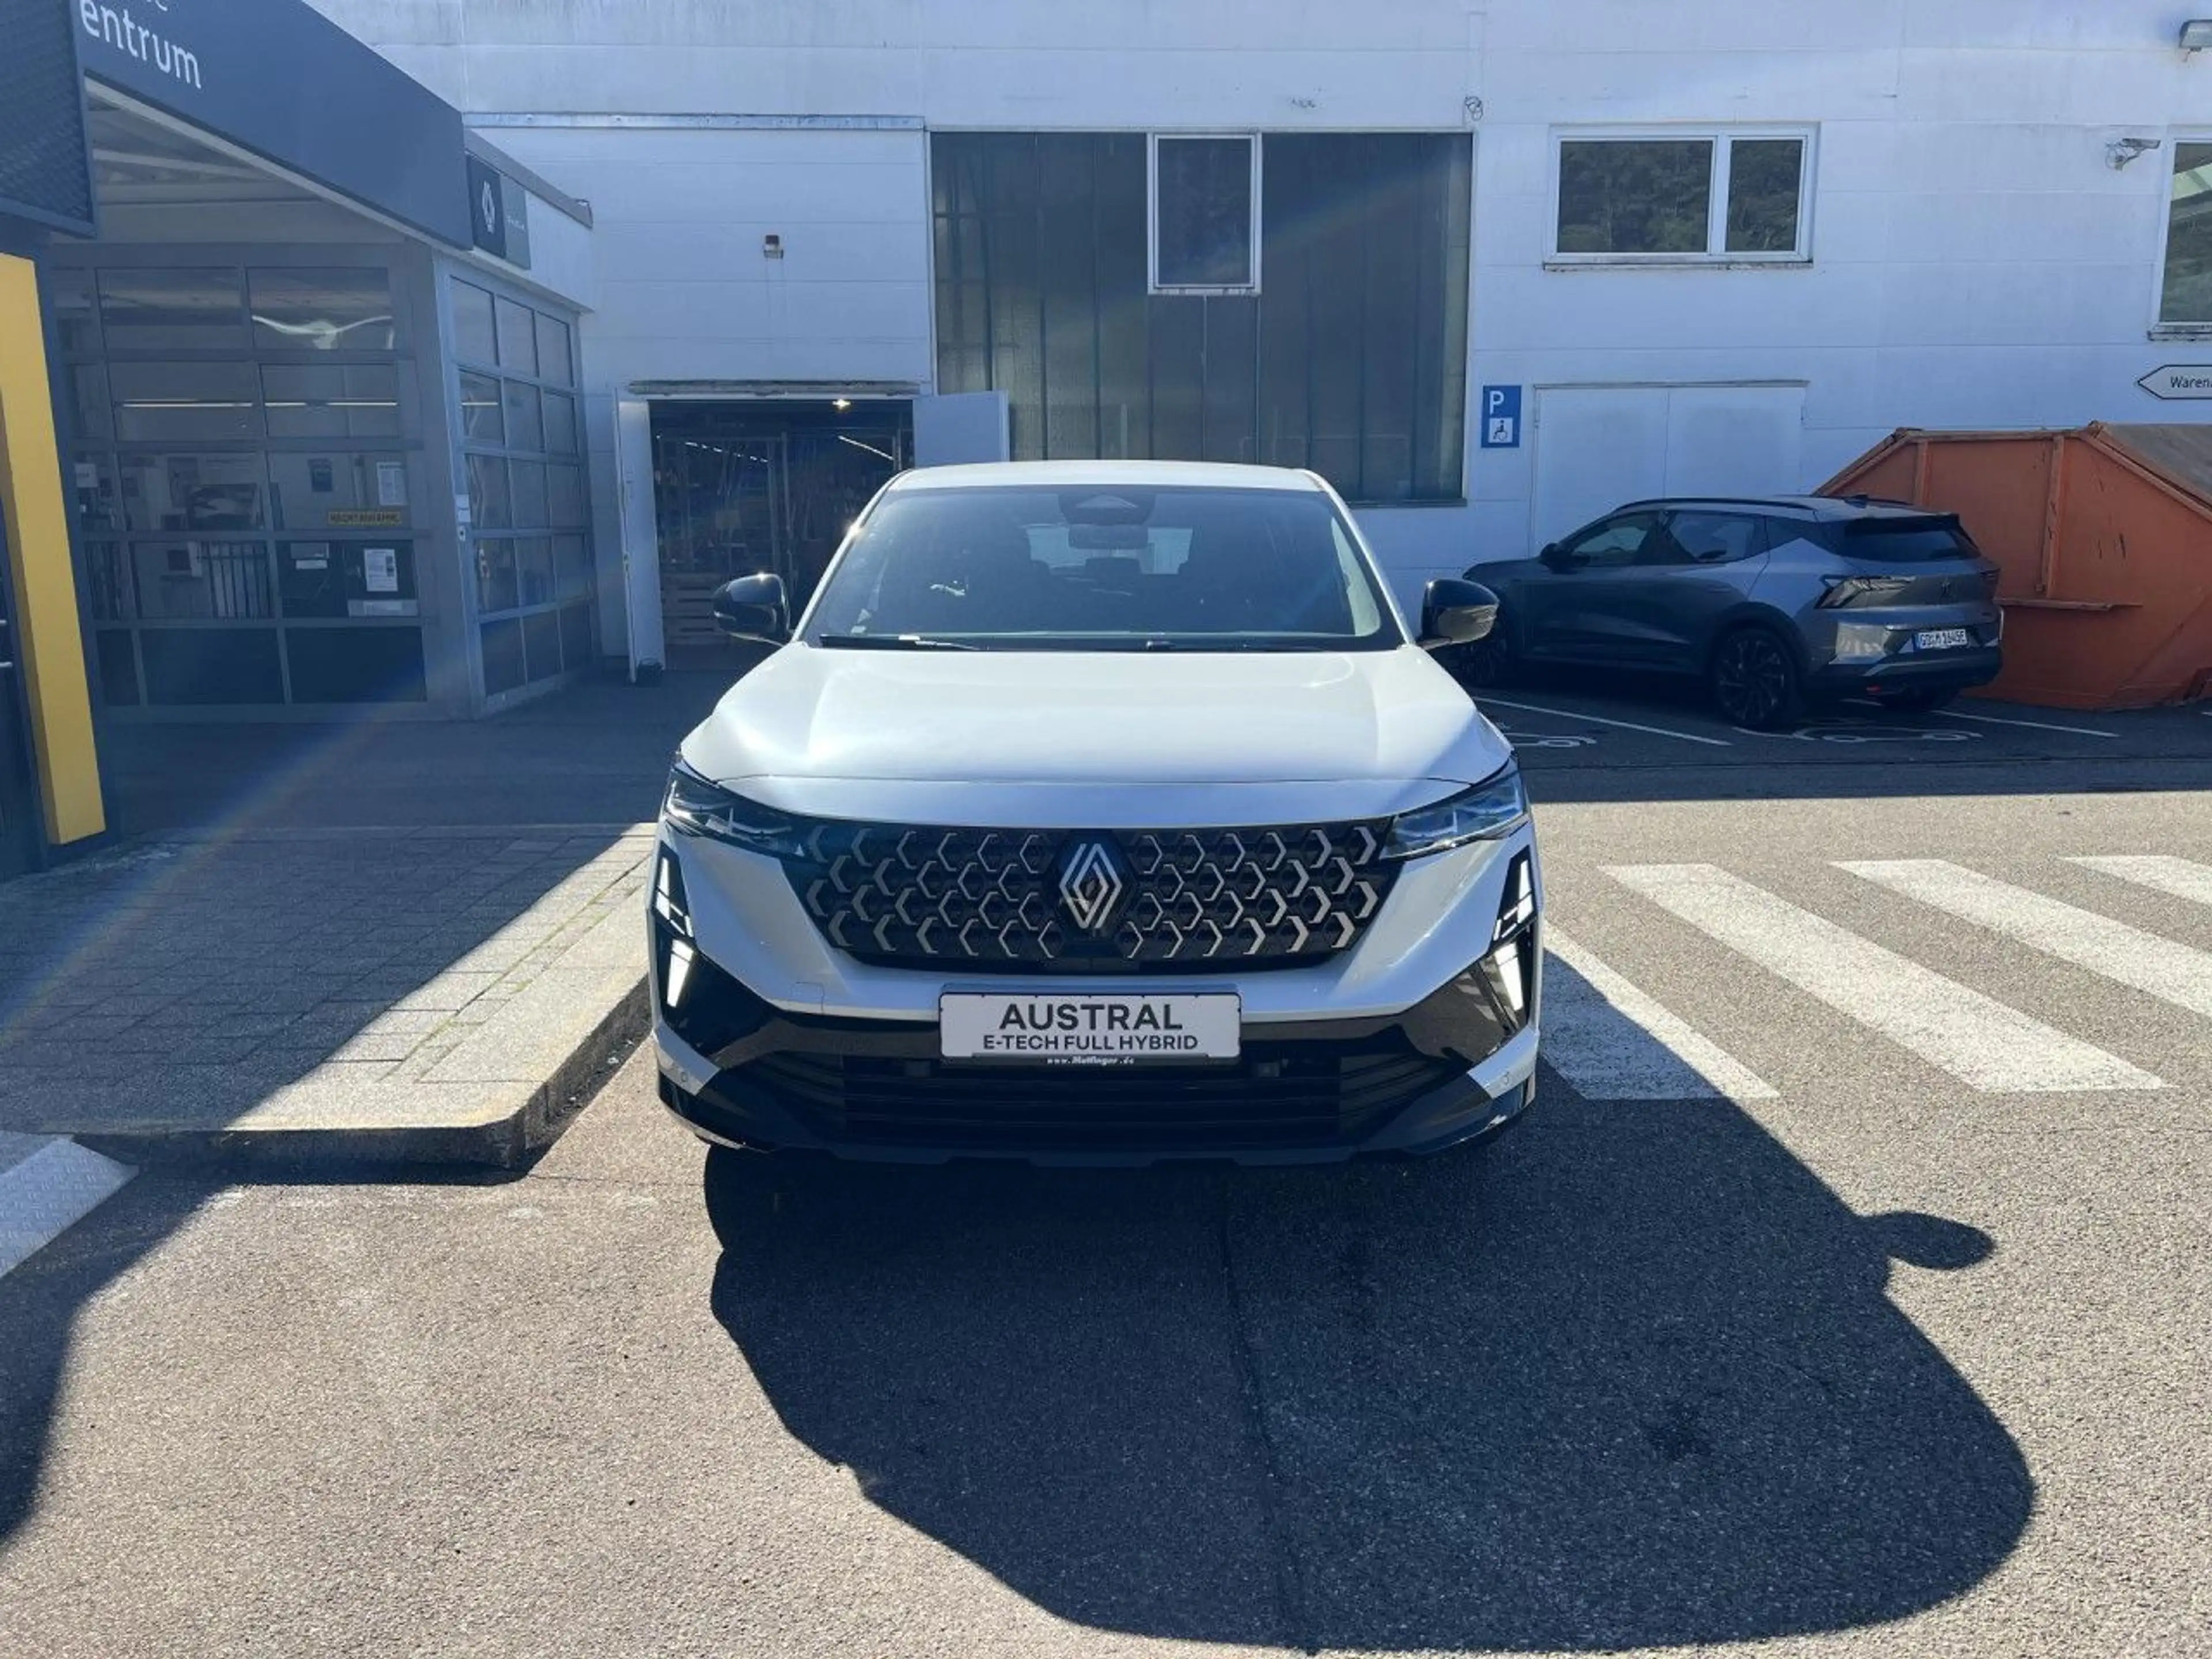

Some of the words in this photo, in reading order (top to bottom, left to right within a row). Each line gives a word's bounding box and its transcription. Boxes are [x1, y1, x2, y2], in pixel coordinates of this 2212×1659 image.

[1490, 391, 1504, 415] P
[999, 1003, 1183, 1031] AUSTRAL
[983, 1035, 1058, 1050] E-TECH
[1064, 1035, 1115, 1050] FULL
[1119, 1035, 1198, 1050] HYBRID
